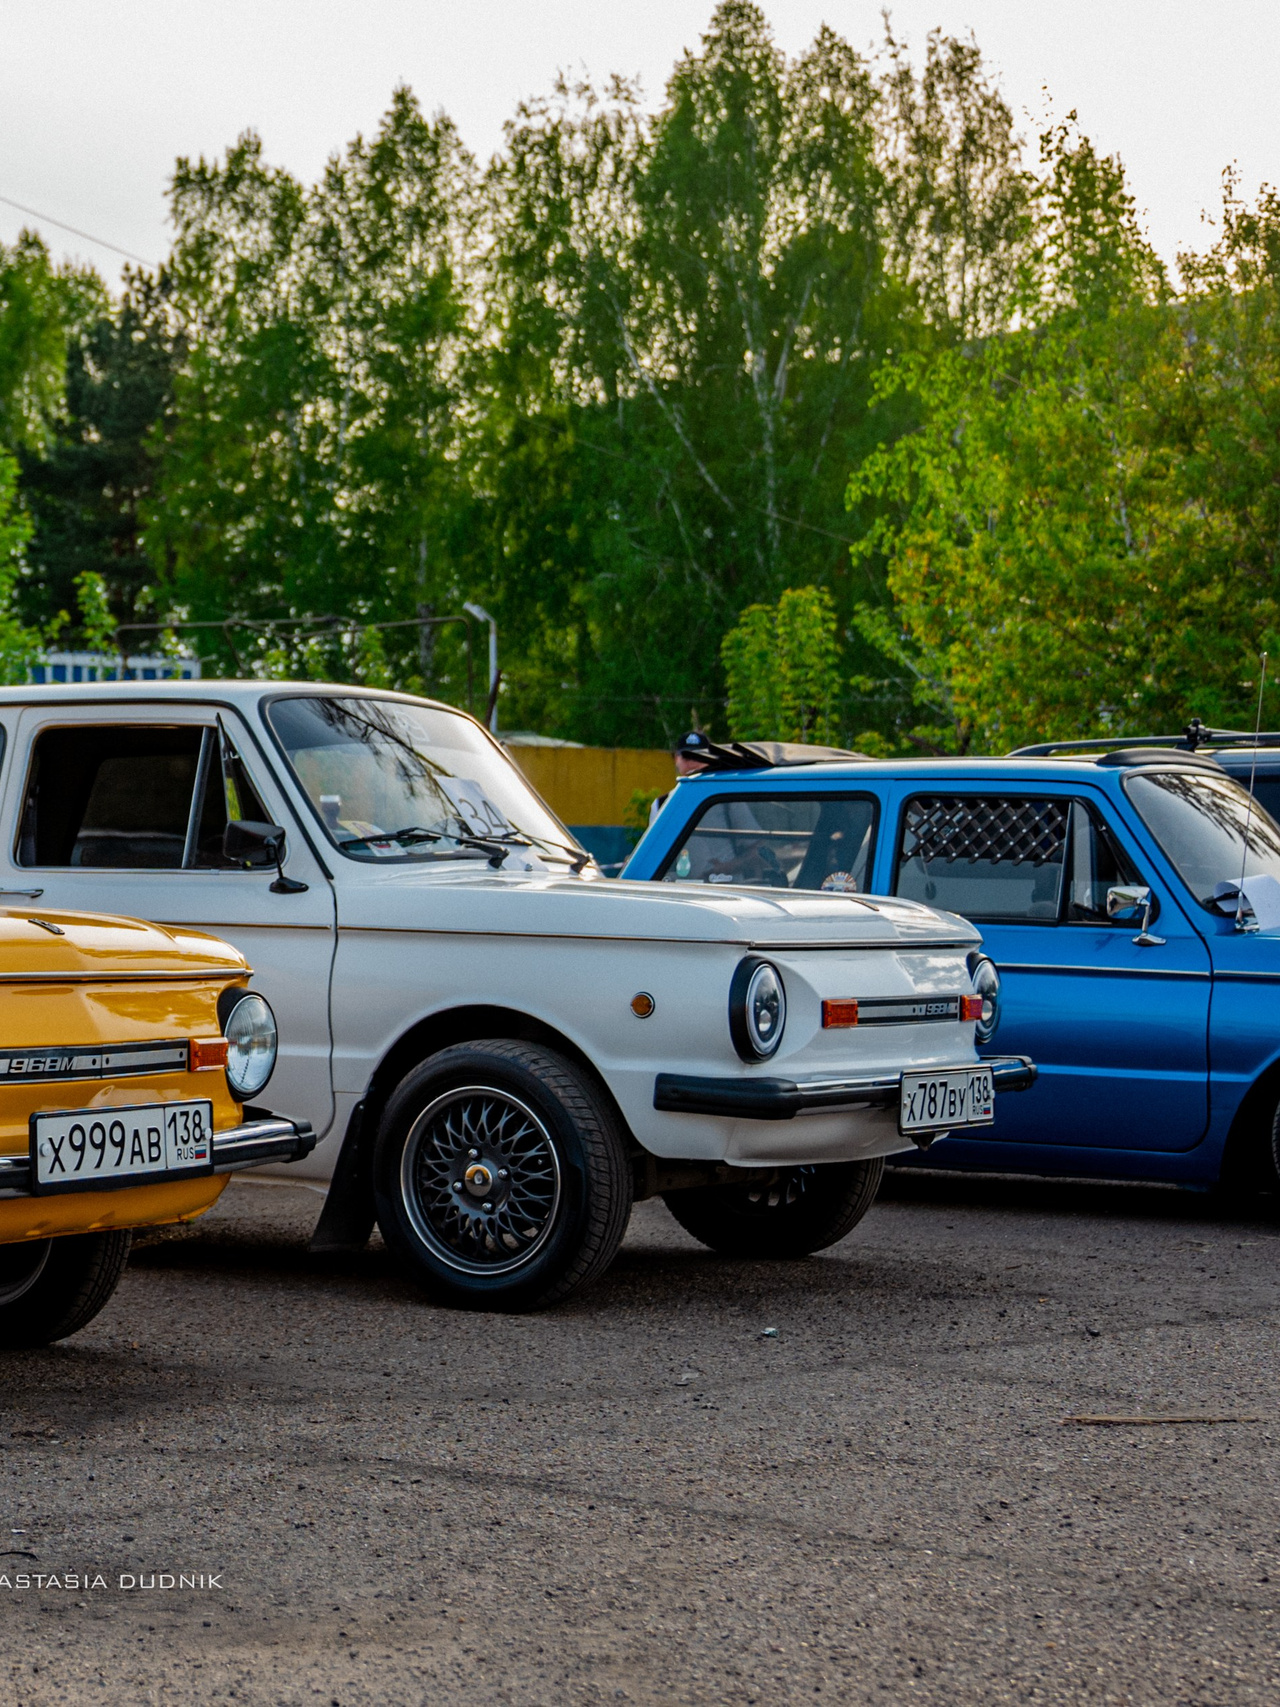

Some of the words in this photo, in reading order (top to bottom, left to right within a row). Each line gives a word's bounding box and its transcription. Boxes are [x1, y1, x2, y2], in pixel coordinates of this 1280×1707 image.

[459, 799, 509, 835] 34
[907, 1080, 966, 1122] Х787ВУ
[968, 1075, 989, 1104] 138
[972, 1105, 983, 1116] RUS
[48, 1120, 161, 1173] Х999АВ
[168, 1109, 202, 1146] 138
[177, 1146, 195, 1160] RUS
